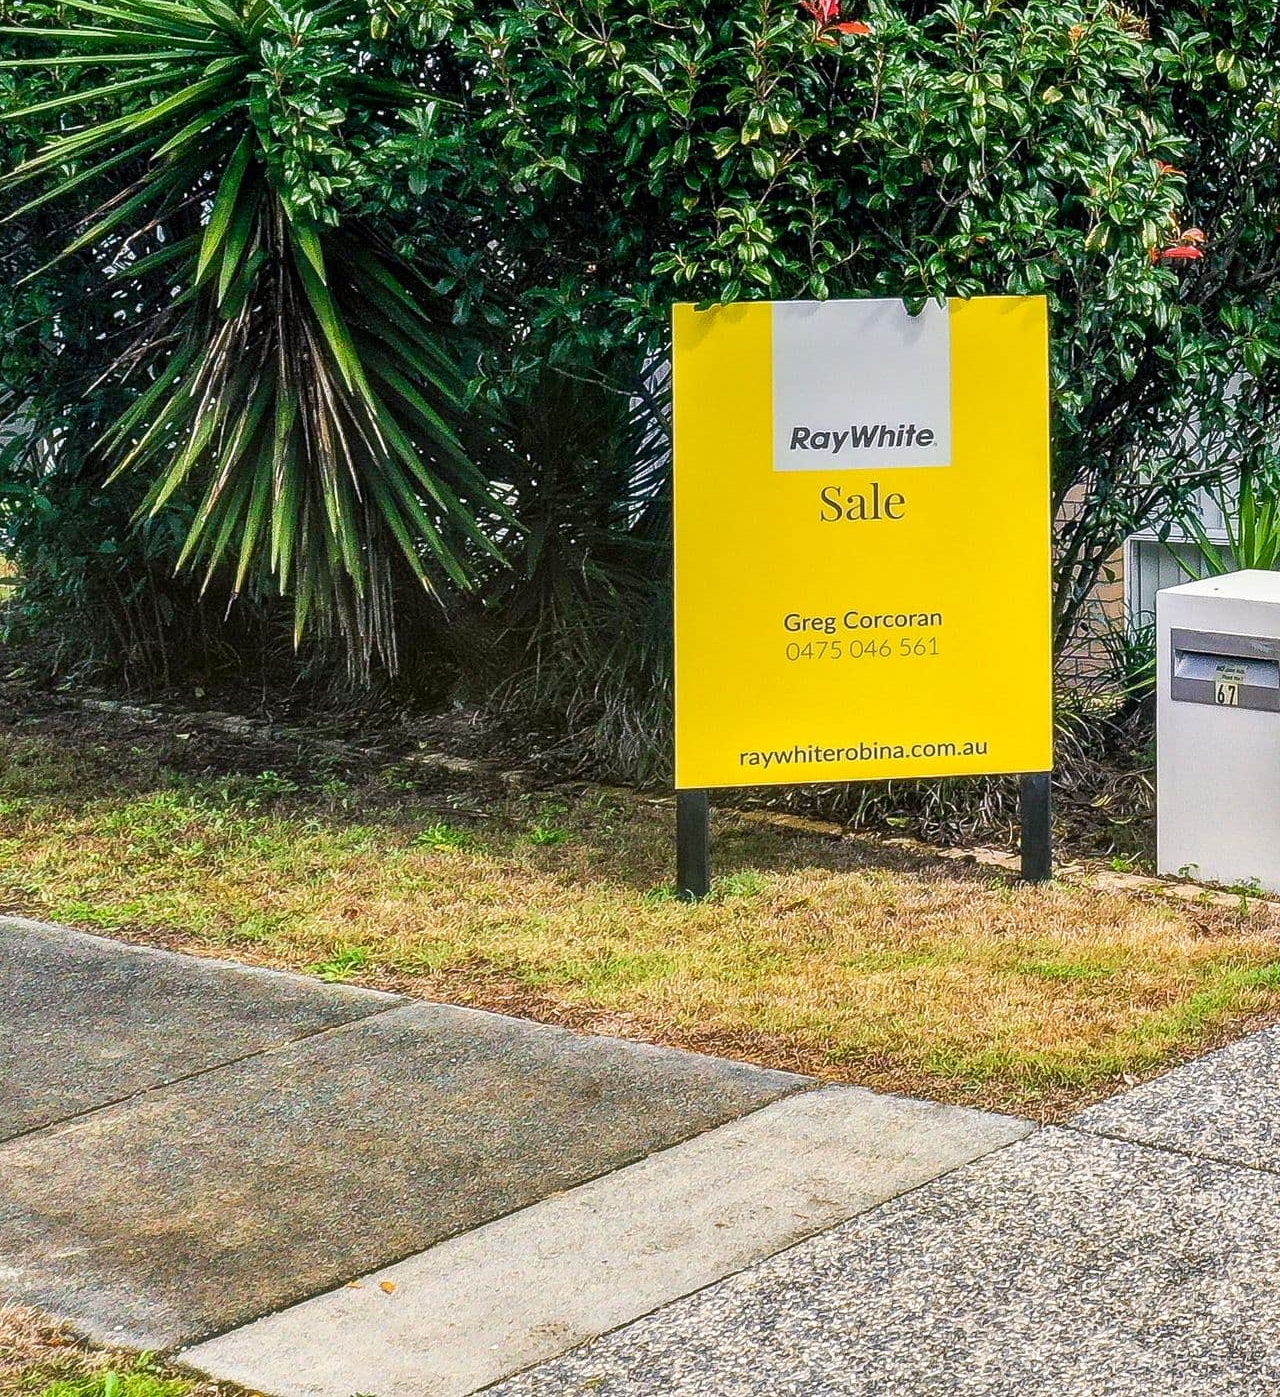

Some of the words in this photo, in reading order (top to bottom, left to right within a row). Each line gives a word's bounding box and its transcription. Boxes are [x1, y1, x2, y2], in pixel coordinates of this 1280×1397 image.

[820, 482, 906, 522] Sale
[784, 613, 836, 635] Greg
[844, 611, 943, 630] Corcoran
[786, 640, 842, 661] 0475
[850, 639, 892, 659] 046
[900, 636, 940, 657] 561
[1217, 684, 1236, 705] 67
[740, 741, 988, 769] raywhiterobina.com.au
